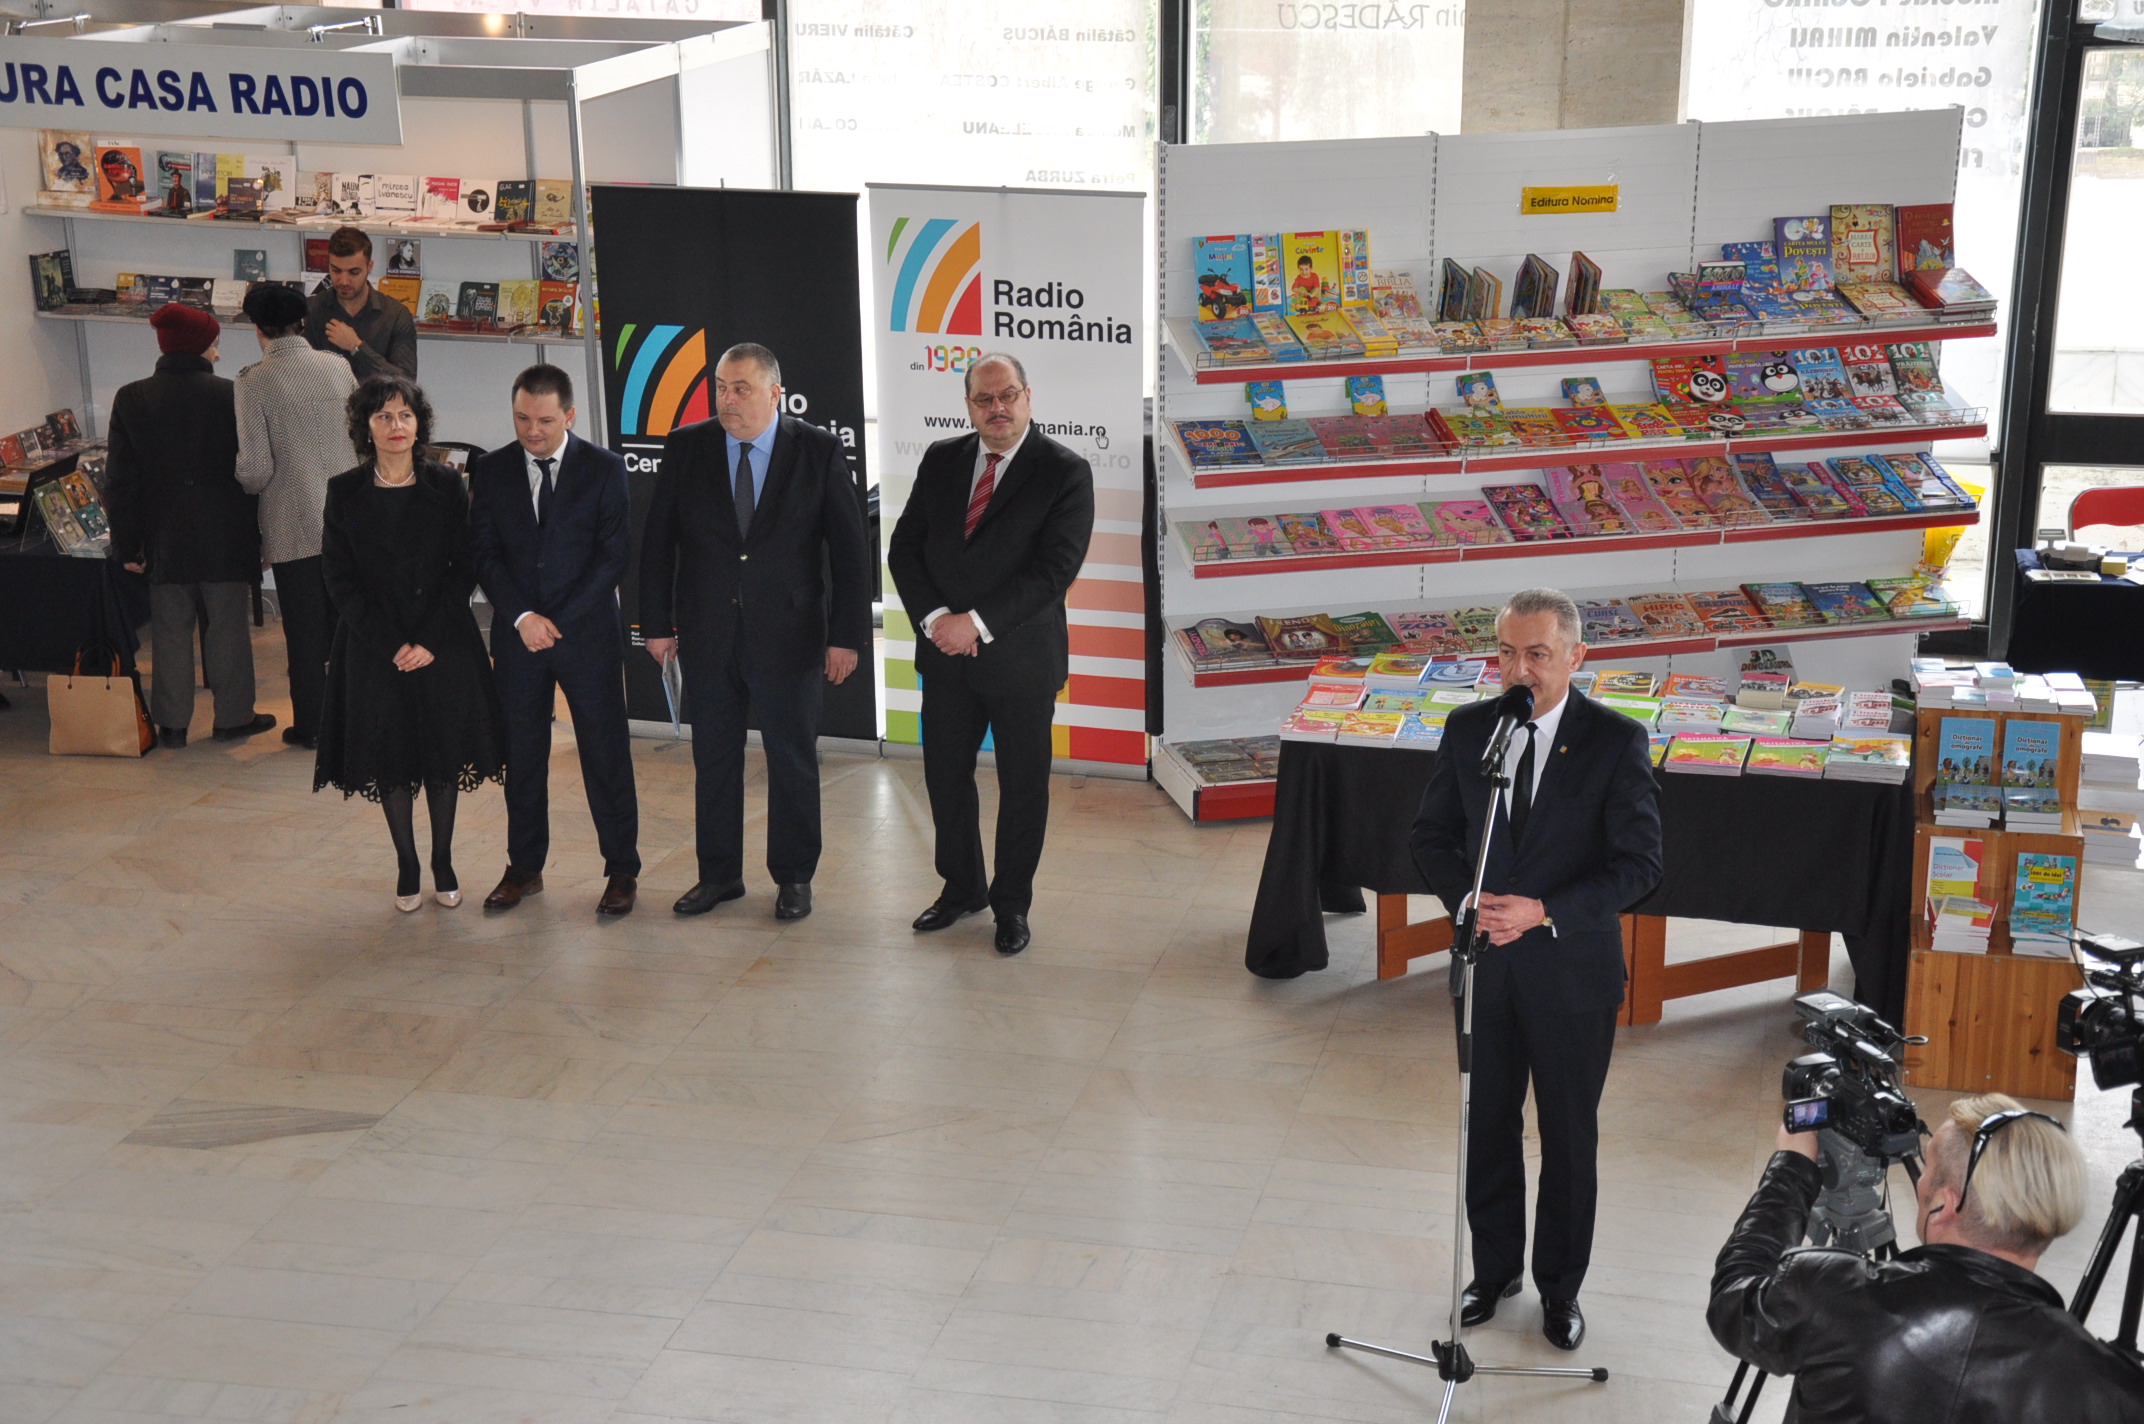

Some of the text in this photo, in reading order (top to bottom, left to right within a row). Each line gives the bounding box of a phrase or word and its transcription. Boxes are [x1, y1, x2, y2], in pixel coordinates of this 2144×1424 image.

[95, 66, 218, 112] CASA
[229, 72, 368, 119] RADIO
[1531, 194, 1614, 207] Editura Nomina
[1296, 246, 1324, 255] Cuvinte
[1377, 278, 1412, 286] BIBLIA
[993, 279, 1084, 309] Radio
[994, 311, 1132, 344] România
[1844, 345, 1885, 362] 101
[1890, 342, 1930, 358] 101
[1794, 349, 1835, 366] 101
[910, 361, 925, 371] din
[1858, 363, 1881, 371] CAI
[1457, 420, 1494, 429] 365
[1184, 428, 1241, 441] 1000
[1643, 603, 1685, 611] HIPIC
[1400, 621, 1448, 630] ZOO
[1750, 649, 1776, 663] 3D
[2015, 746, 2048, 754] omografe
